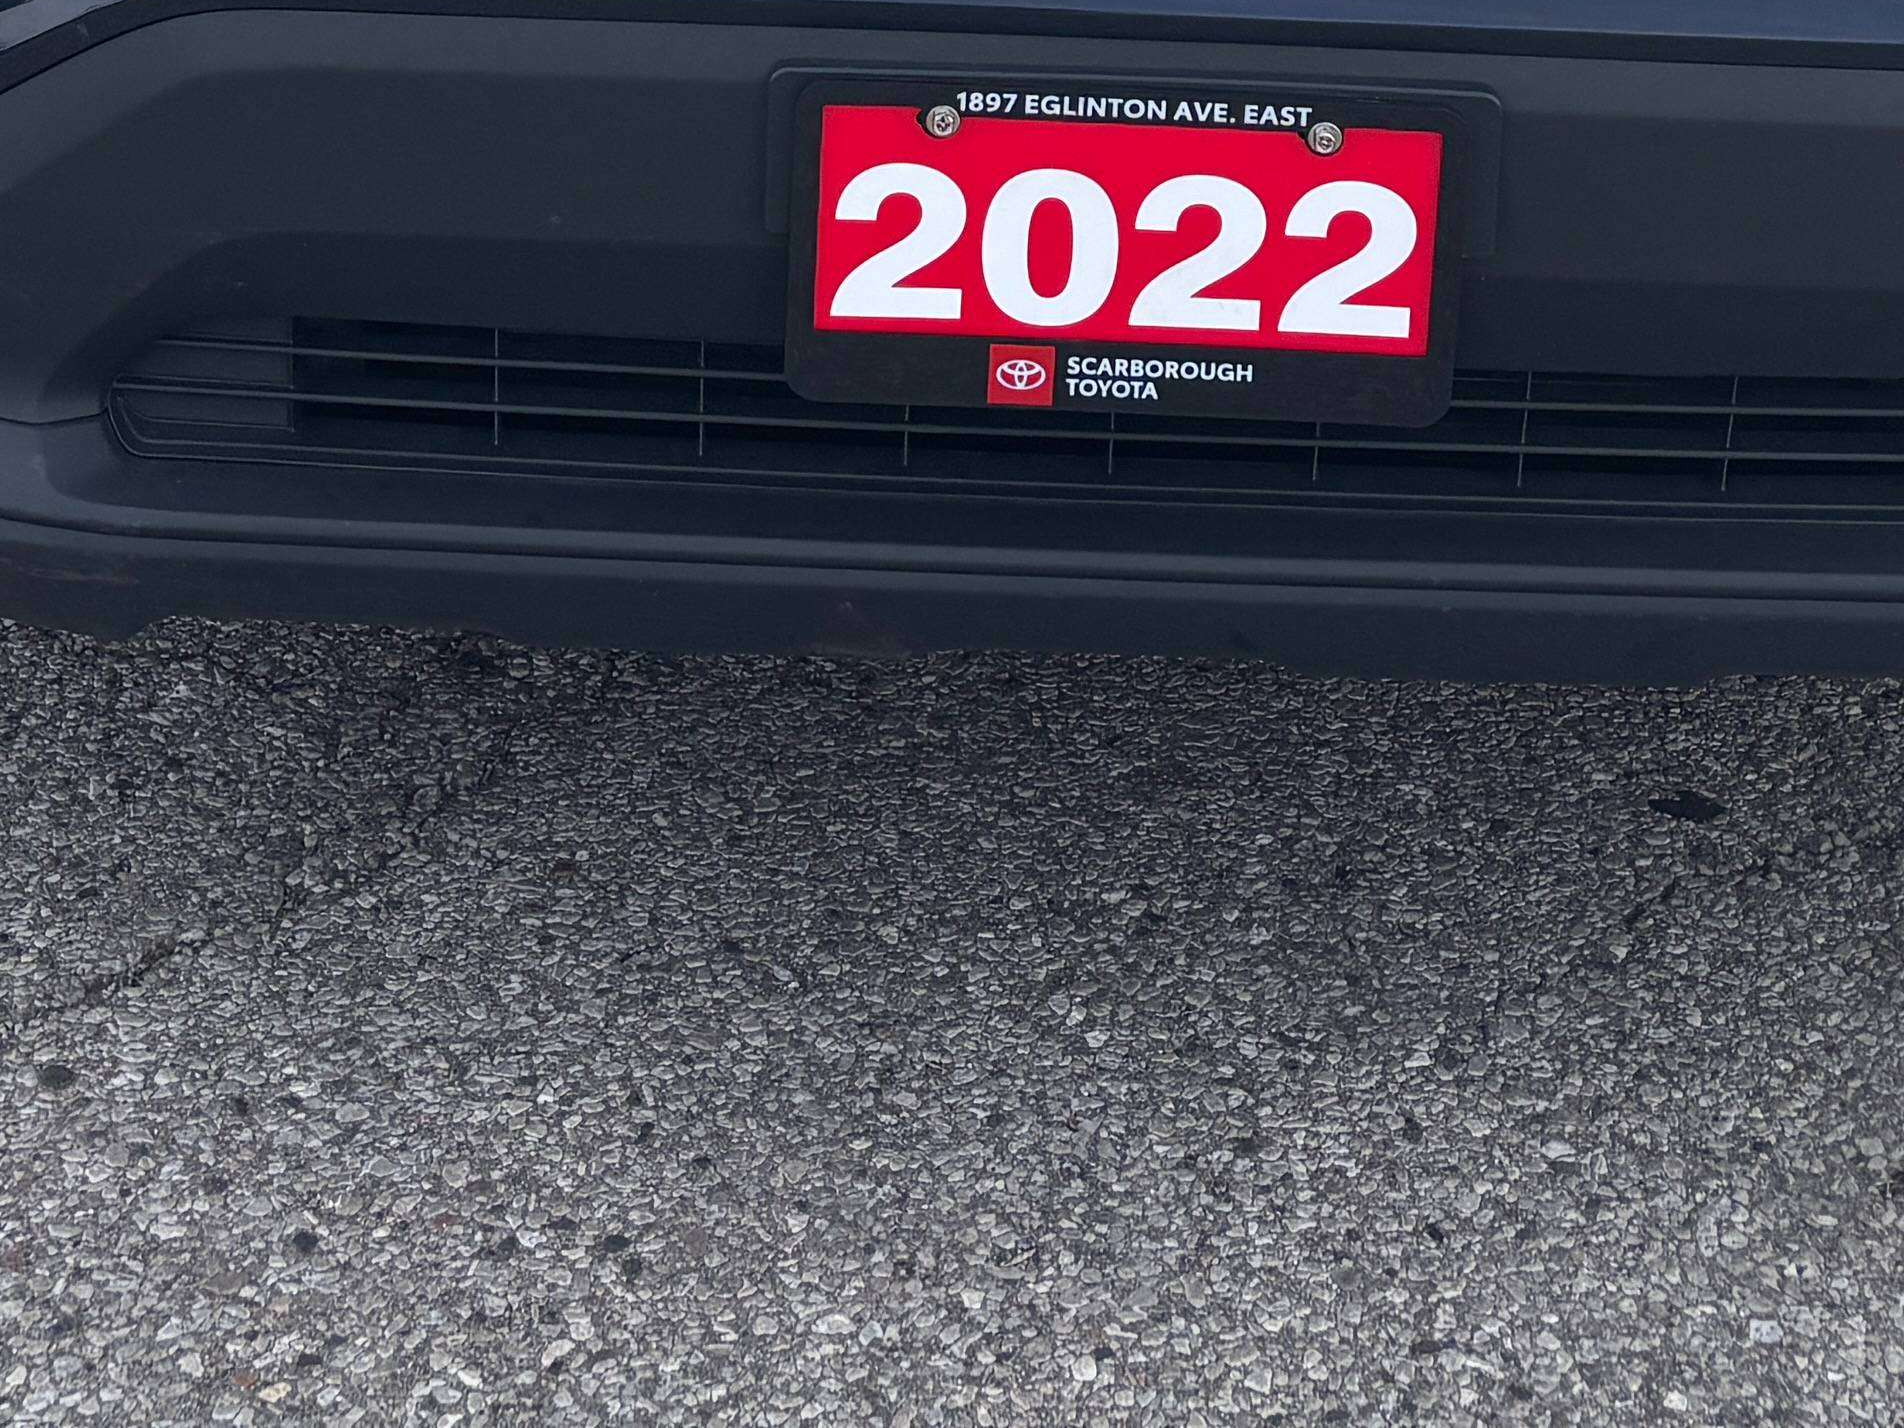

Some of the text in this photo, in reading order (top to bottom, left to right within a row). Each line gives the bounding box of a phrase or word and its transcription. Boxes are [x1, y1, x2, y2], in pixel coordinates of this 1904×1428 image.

[956, 91, 1312, 128] 1897 EGLINTON AVE. EAST
[829, 162, 1418, 339] 2022
[1066, 356, 1254, 383] SCARBOROUGH
[1065, 378, 1159, 401] TOYOTA
